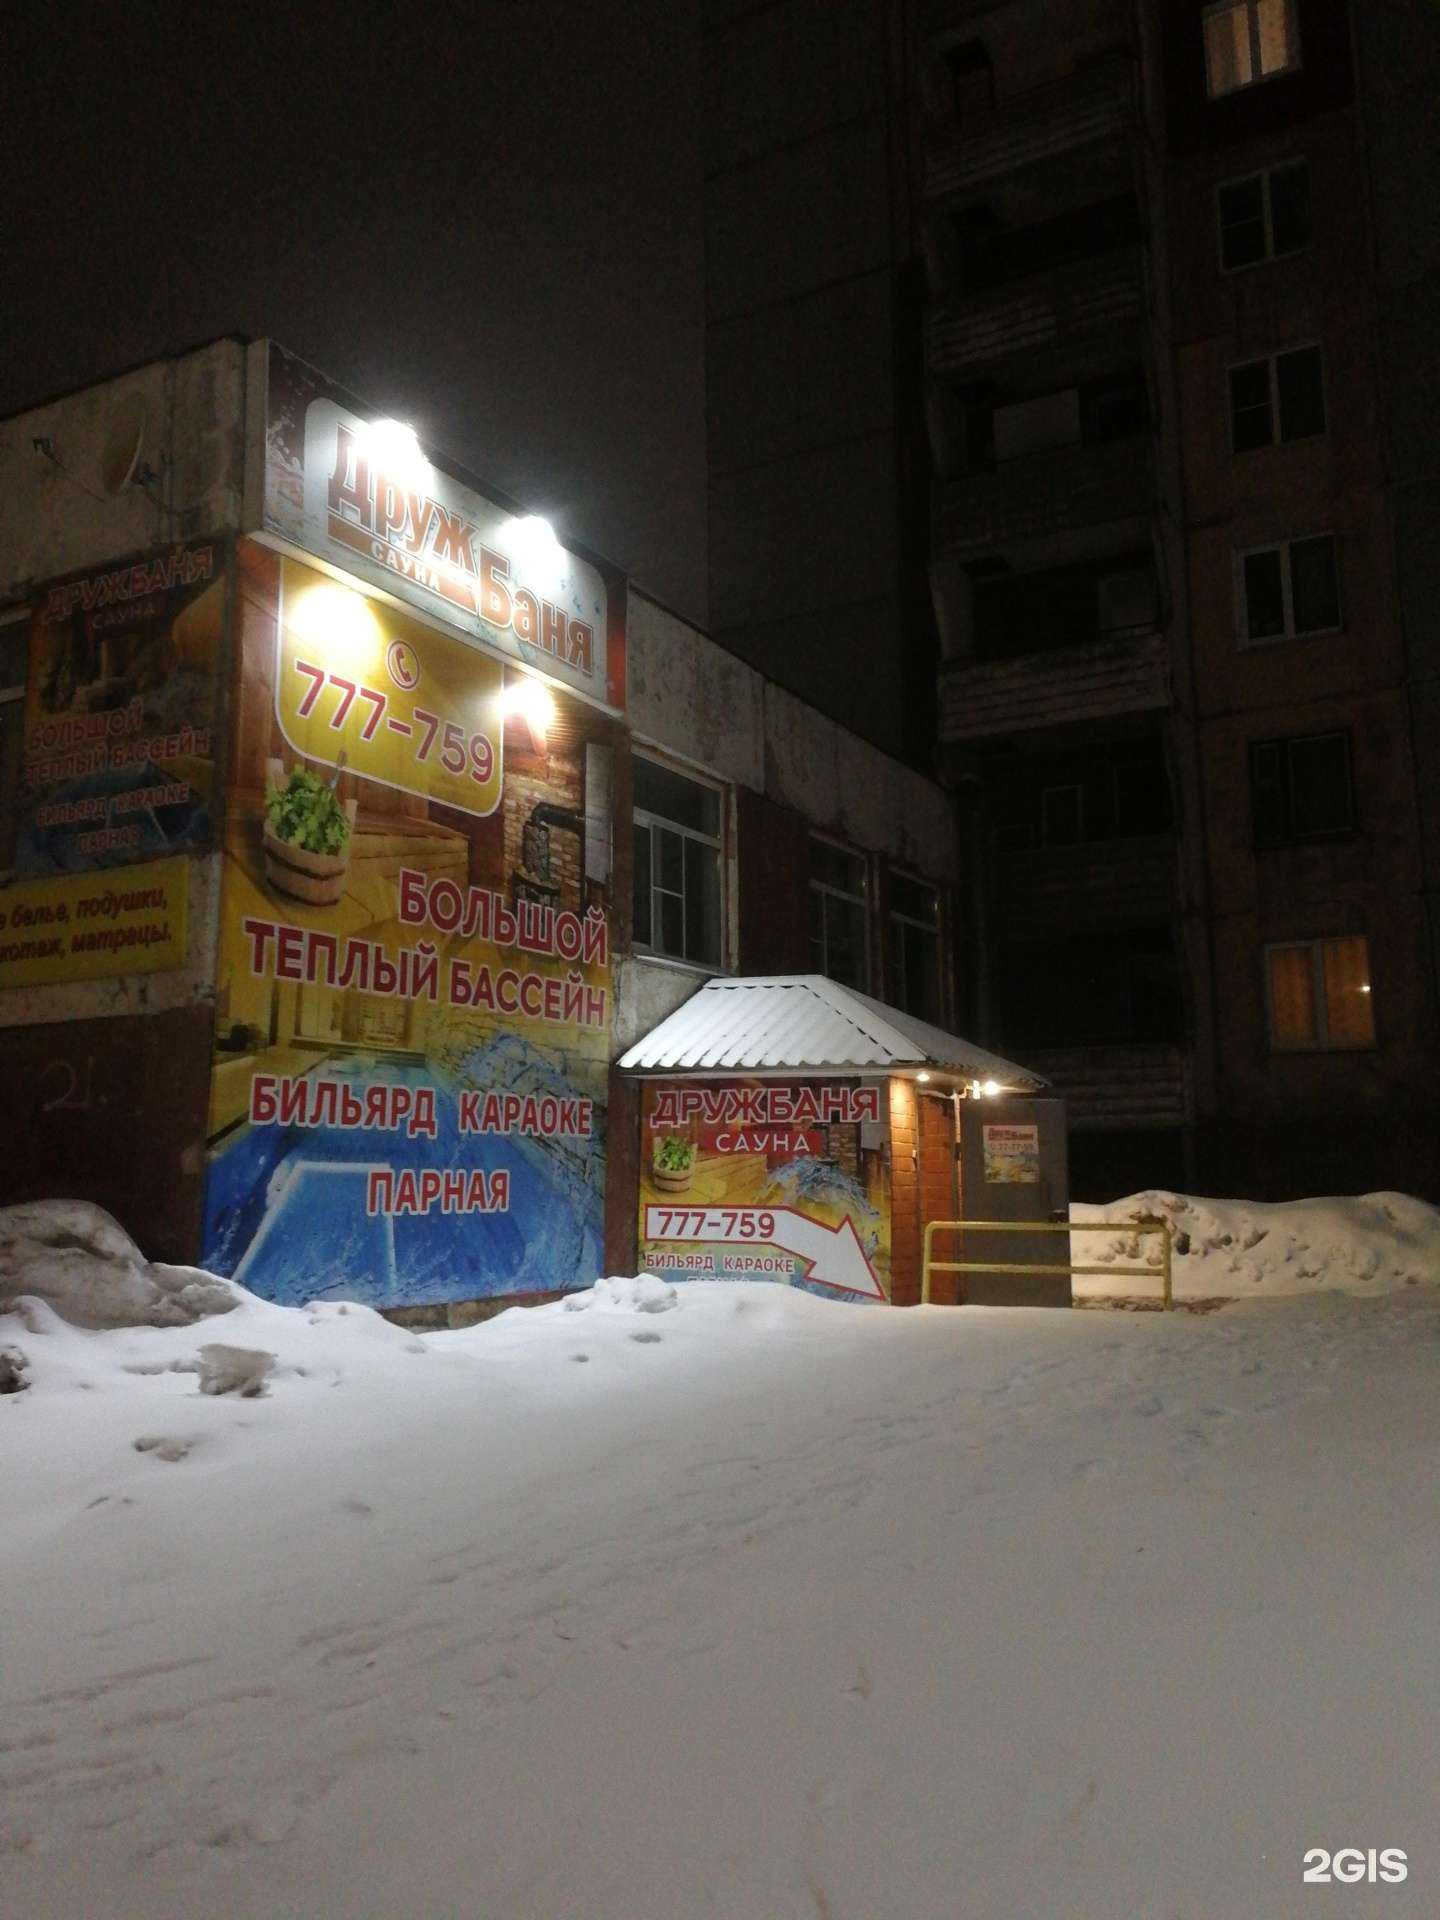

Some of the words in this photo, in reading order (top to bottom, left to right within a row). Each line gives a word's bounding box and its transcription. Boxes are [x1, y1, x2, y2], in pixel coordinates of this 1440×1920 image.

[371, 541, 441, 592] САУНА
[296, 659, 495, 785] 777-759
[400, 867, 609, 967] БОЛЬШОЙ
[243, 918, 439, 1002] ТЕПЛЫЙ
[450, 960, 607, 1029] БАССЕЙН
[250, 1074, 438, 1138] БИЛЬЯРД
[459, 1090, 593, 1137] КАРАОКЕ
[650, 1085, 880, 1128] ДРУЖБАНЯ
[716, 1133, 811, 1152] САУНА
[367, 1168, 510, 1216] ПАРНАЯ
[657, 1212, 775, 1238] 777-759
[646, 1253, 715, 1271] БИЛЬЯРД
[724, 1256, 795, 1273] КАРАОКЕ
